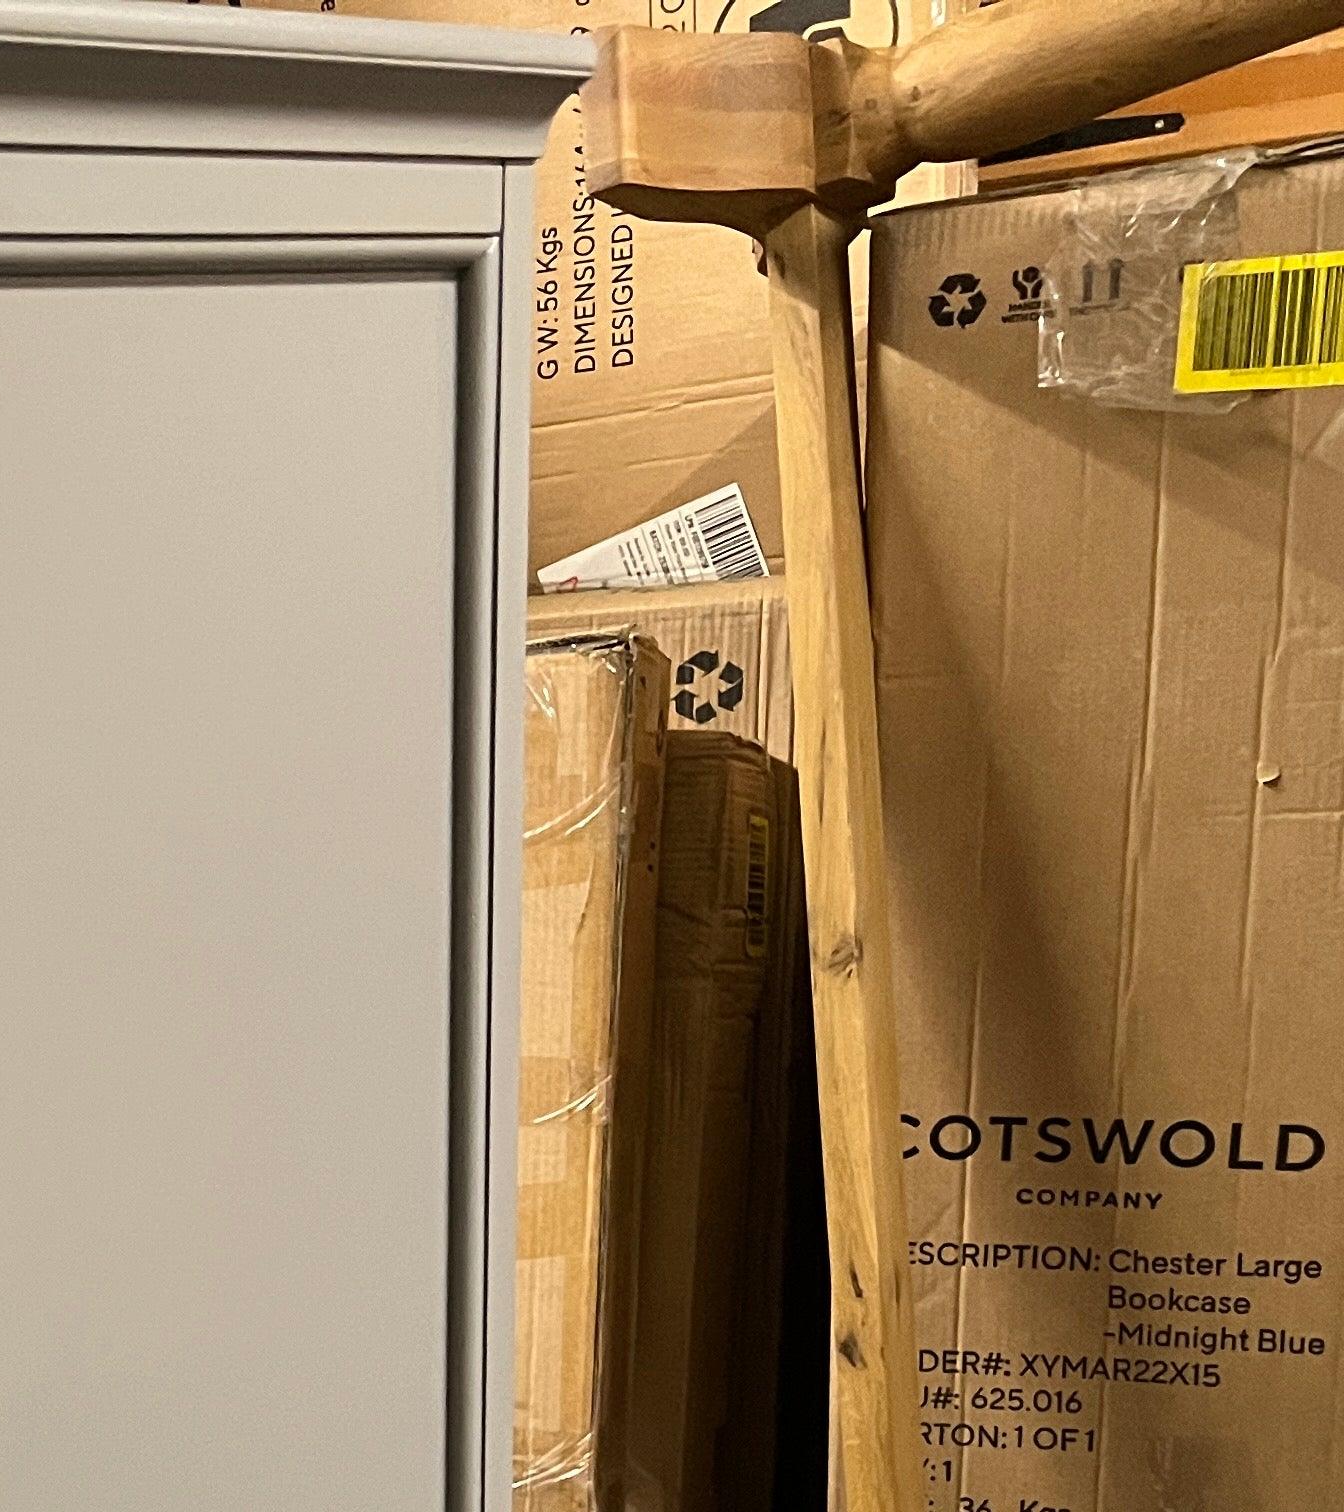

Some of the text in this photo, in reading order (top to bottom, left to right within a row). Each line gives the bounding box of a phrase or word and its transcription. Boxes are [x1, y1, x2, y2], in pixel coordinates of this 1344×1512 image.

[537, 227, 563, 274] Kgs
[537, 280, 558, 312] 56
[612, 224, 634, 367] DESIGNED
[1016, 1188, 1162, 1209] COMPANY
[1109, 1249, 1227, 1276] Chester
[1237, 1253, 1322, 1284] Large
[1108, 1285, 1251, 1314] Bookcase
[1103, 1322, 1325, 1355] -Midnight Blue
[918, 1349, 1221, 1388] DER#: XYMAR22X15
[971, 1386, 1083, 1414] 625.016
[1033, 1427, 1080, 1452] OF
